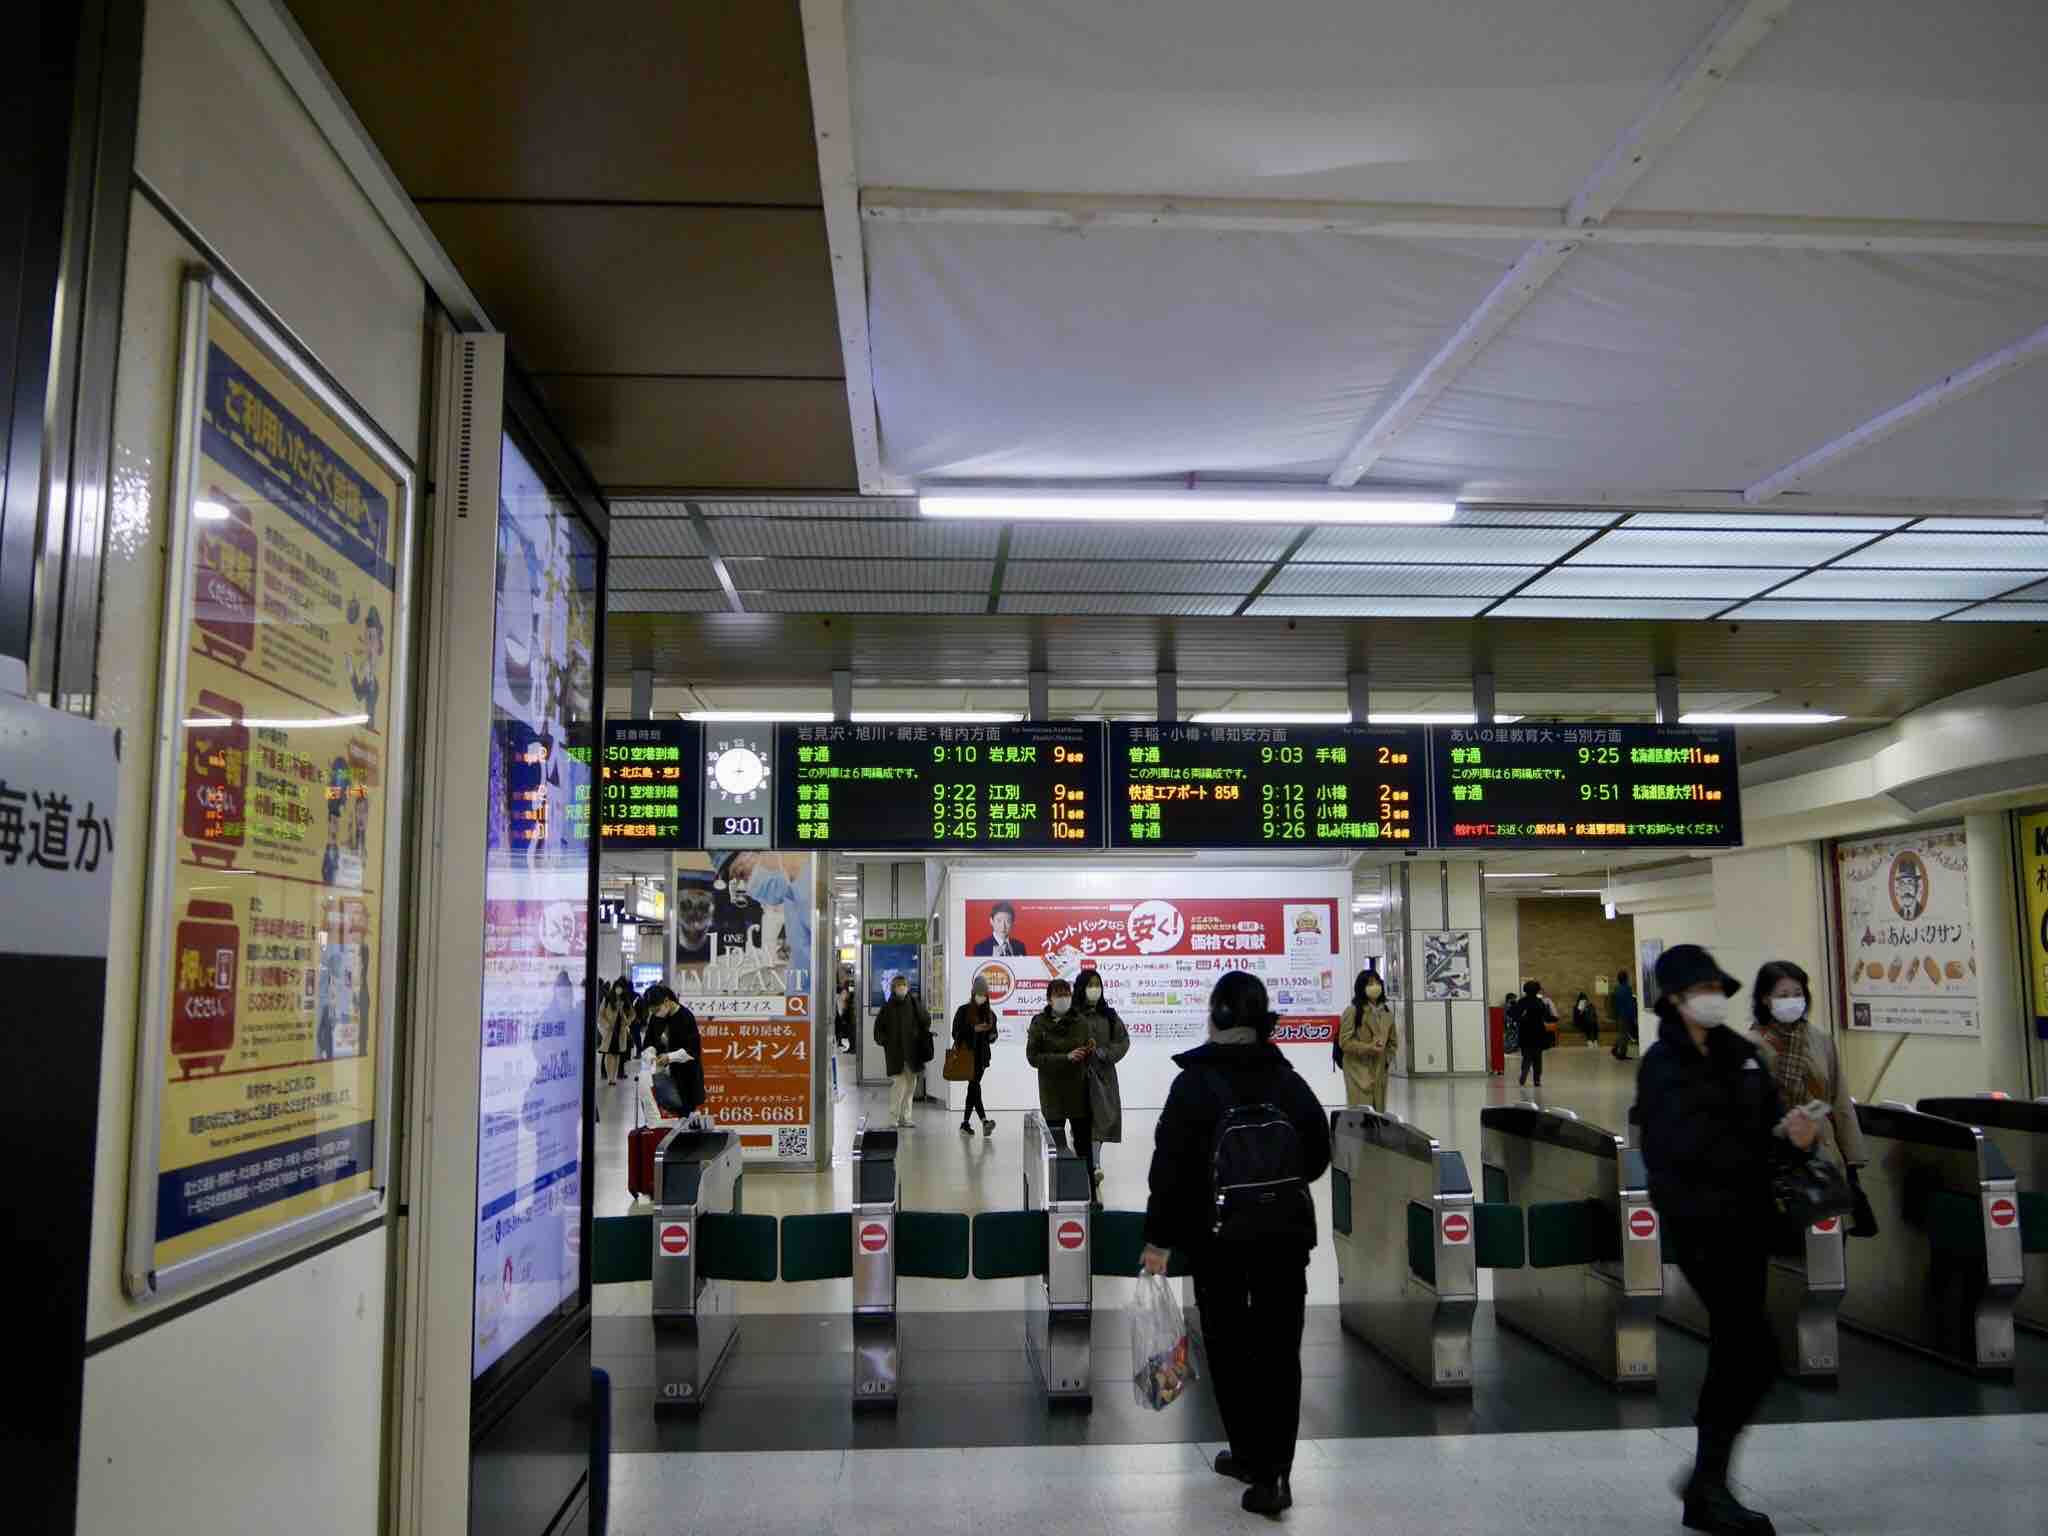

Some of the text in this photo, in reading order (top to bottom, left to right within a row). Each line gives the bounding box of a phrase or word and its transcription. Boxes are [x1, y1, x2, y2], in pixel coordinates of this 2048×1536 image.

[798, 746, 830, 762] 普通
[934, 746, 977, 762] 9:10
[989, 746, 1036, 762] 岩見沢
[1129, 747, 1160, 763] 普通
[1261, 747, 1303, 763] 9:03
[1315, 748, 1347, 764] 手稲
[1451, 748, 1481, 763] 普通
[1578, 747, 1620, 763] 9:25
[797, 784, 830, 800] 普通
[934, 784, 976, 800] 9:22
[989, 784, 1020, 800] 江別
[1128, 784, 1207, 800] 快速エアポート
[1214, 785, 1239, 800] 85号
[1262, 784, 1304, 801] 9:12
[1316, 784, 1348, 801] 小樽
[1452, 785, 1483, 800] 普通
[1580, 784, 1619, 800] 9:51
[797, 803, 830, 819] 普通
[934, 803, 977, 819] 9:36
[989, 803, 1037, 819] 岩見沢
[1129, 803, 1161, 819] 普通
[1262, 803, 1305, 820] 9:16
[1316, 803, 1348, 820] 小樽
[724, 818, 760, 834] 9:01
[797, 822, 829, 839] 普通
[934, 822, 977, 839] 9:45
[988, 822, 1020, 838] 江別
[1129, 822, 1161, 839] 普通
[1263, 822, 1306, 839] 9:26
[723, 934, 745, 944] ONE
[1080, 932, 1127, 954] もっと
